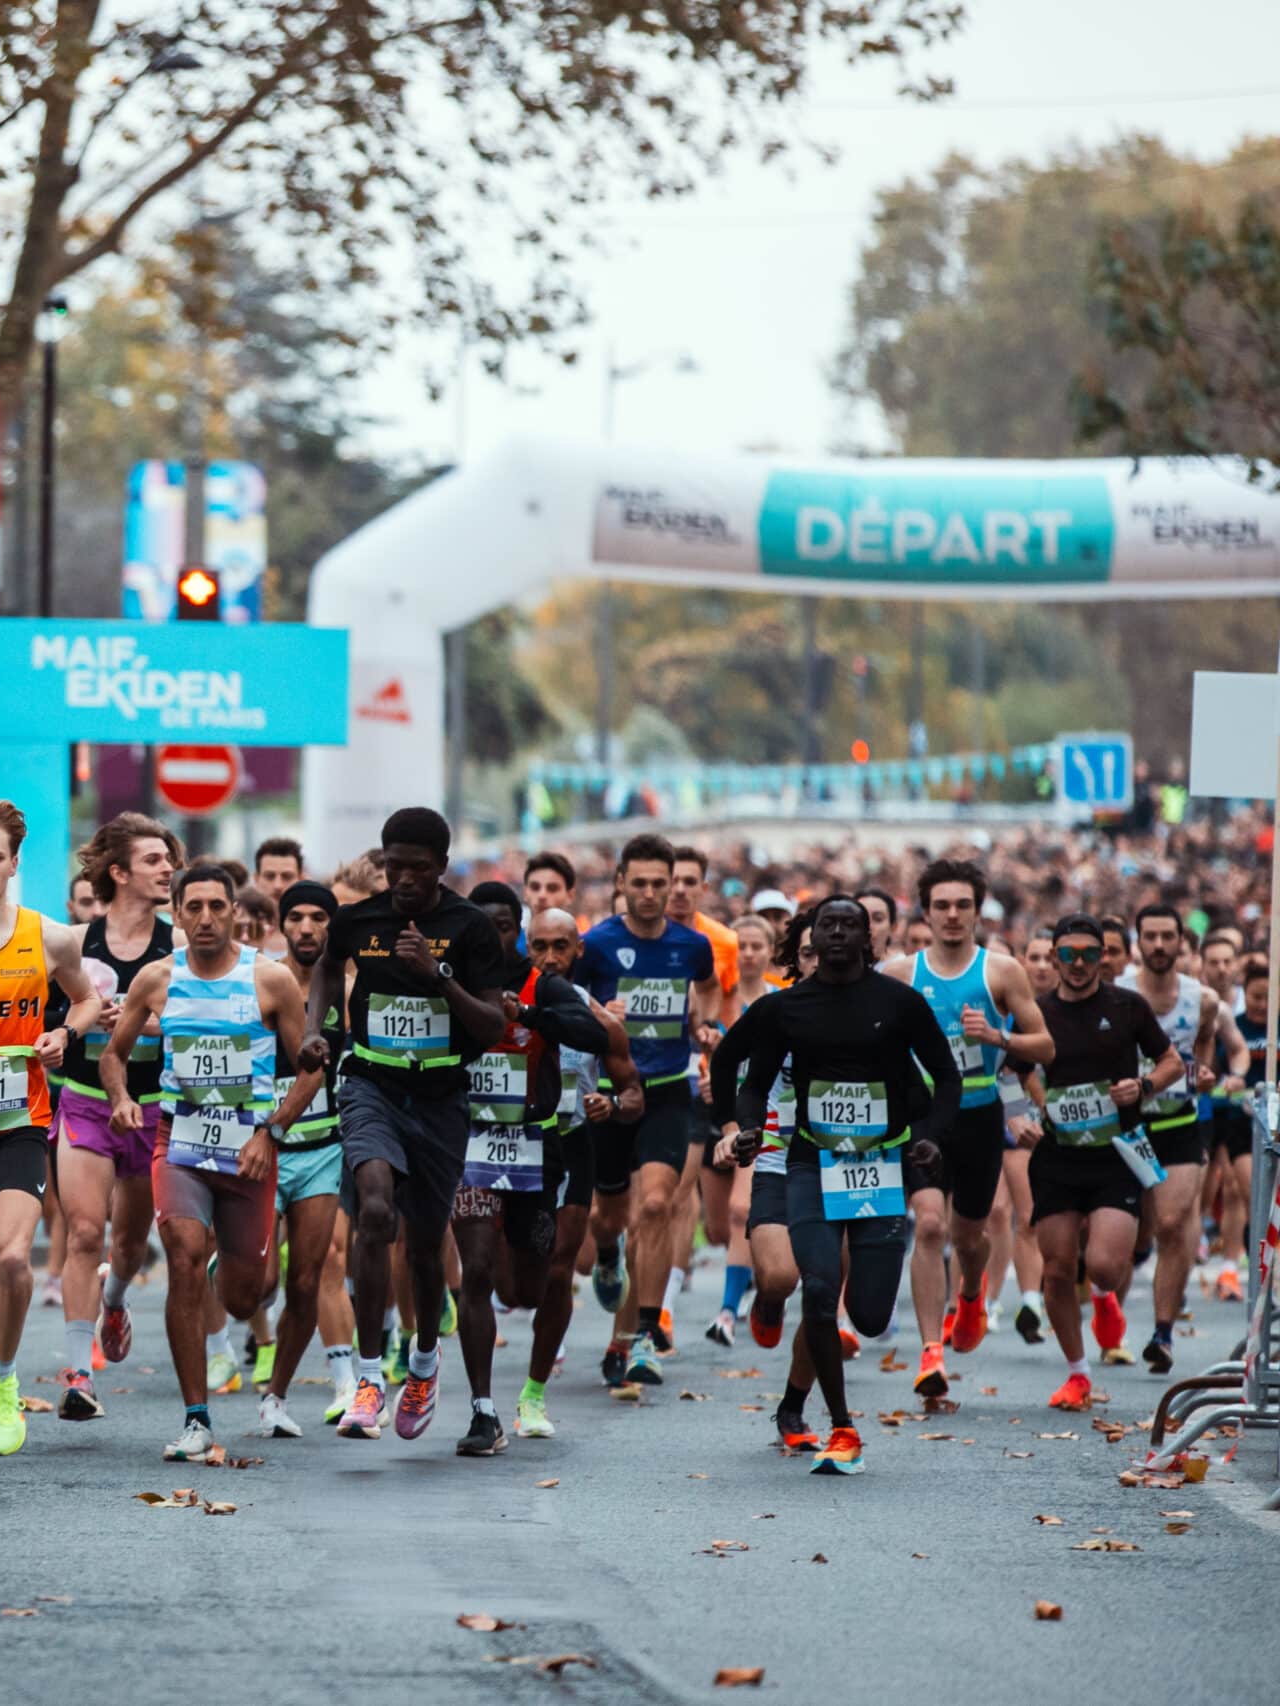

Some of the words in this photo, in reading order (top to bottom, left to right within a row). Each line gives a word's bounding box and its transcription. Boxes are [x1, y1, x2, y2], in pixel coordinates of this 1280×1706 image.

[794, 497, 1072, 564] DÉPART
[31, 635, 138, 669] MAIF
[160, 707, 193, 728] DE
[197, 708, 267, 729] PARIS
[640, 981, 670, 991] MAIF
[18, 995, 41, 1018] 91
[392, 1000, 430, 1012] MAIF
[631, 994, 672, 1013] 206-1
[382, 1015, 431, 1037] 1121-1
[194, 1039, 232, 1050] MAIF
[192, 1053, 228, 1076] 79-1
[471, 1071, 509, 1093] 05-1
[830, 1085, 869, 1098] MAIF
[1065, 1088, 1095, 1100] MAIF
[198, 1107, 236, 1121] MAIF
[821, 1101, 871, 1123] 1123-1
[1060, 1100, 1103, 1122] 996-1
[202, 1123, 222, 1145] 79
[487, 1141, 518, 1162] 205
[842, 1167, 880, 1189] 1123
